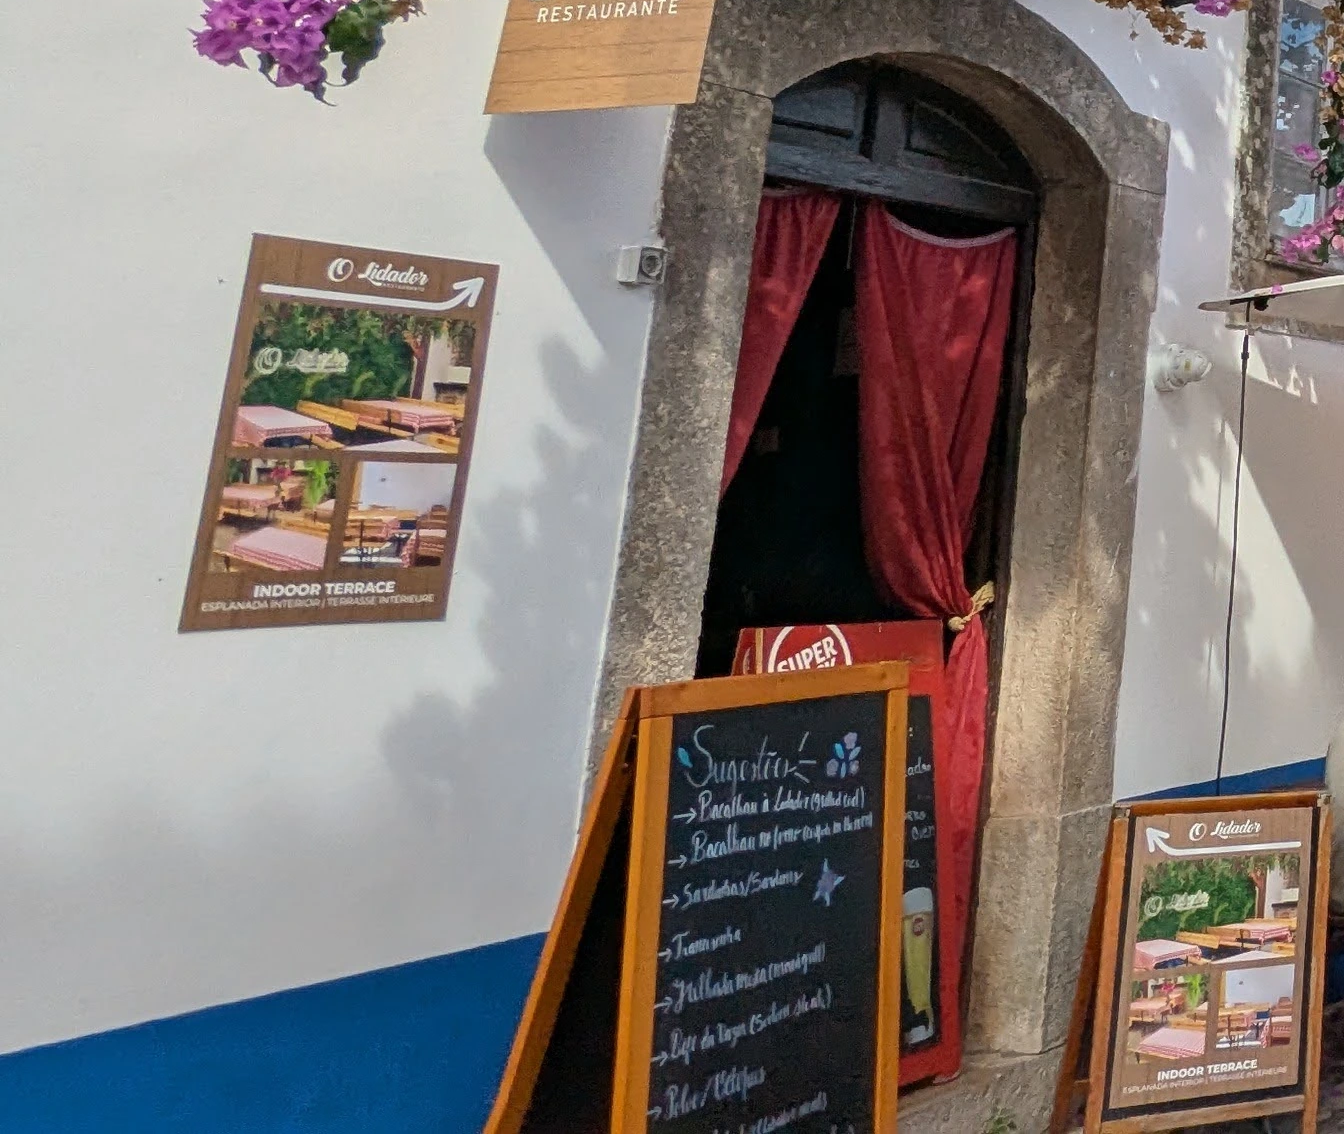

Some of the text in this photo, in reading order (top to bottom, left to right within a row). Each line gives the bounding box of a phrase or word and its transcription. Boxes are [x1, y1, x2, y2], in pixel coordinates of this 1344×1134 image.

[327, 258, 429, 287] O Lidador
[253, 580, 397, 598] INDOOR TERRACE
[777, 636, 838, 673] SUPER
[1189, 819, 1262, 841] O Lidador
[1157, 1059, 1258, 1082] INDOOR TERRACE
